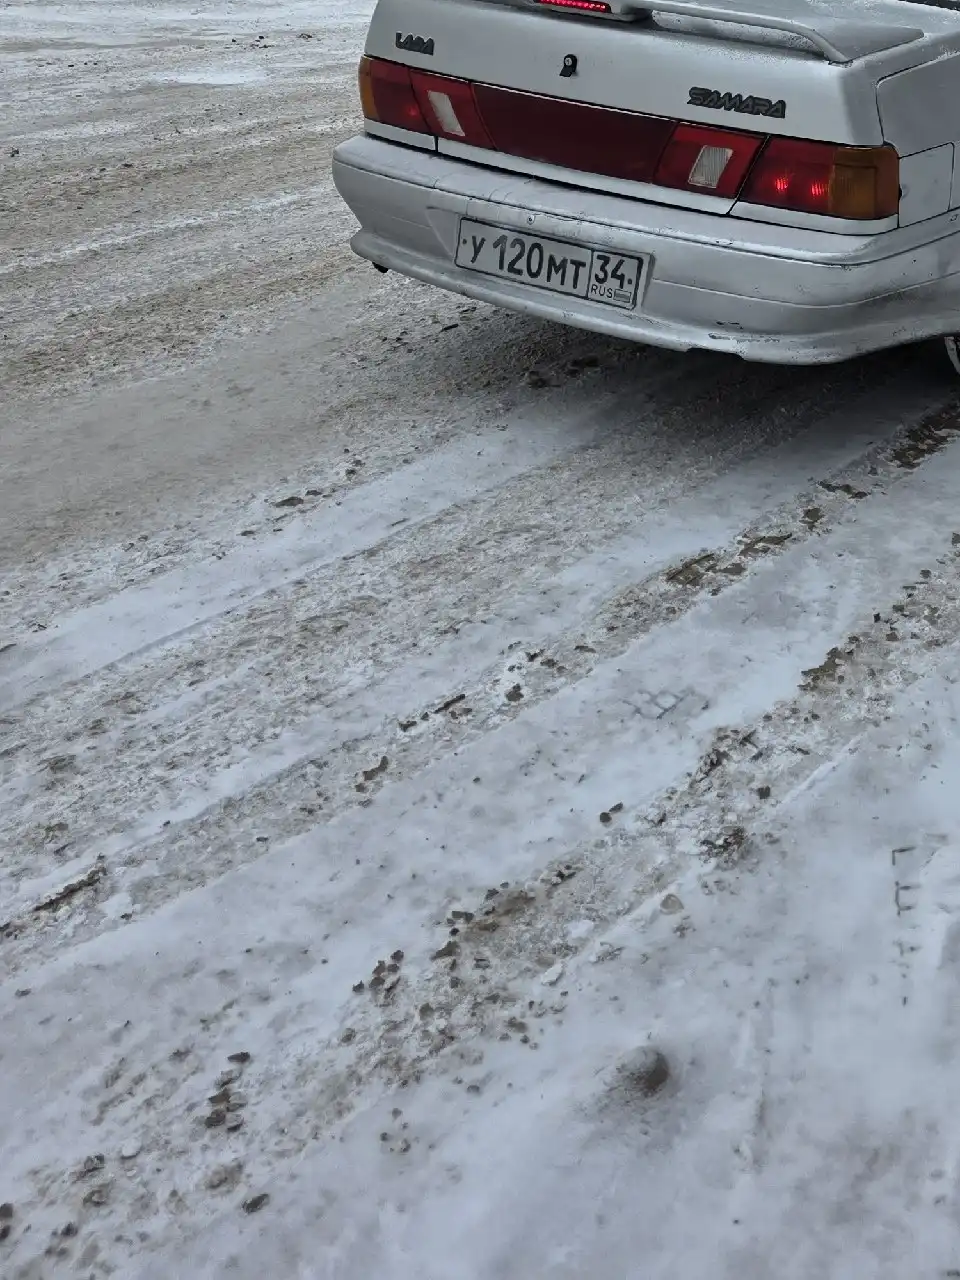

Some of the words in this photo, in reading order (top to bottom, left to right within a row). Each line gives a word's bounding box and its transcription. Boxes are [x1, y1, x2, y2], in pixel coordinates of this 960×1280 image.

[395, 31, 434, 56] LADA
[687, 86, 786, 119] SAMARA
[590, 284, 613, 299] RUS
